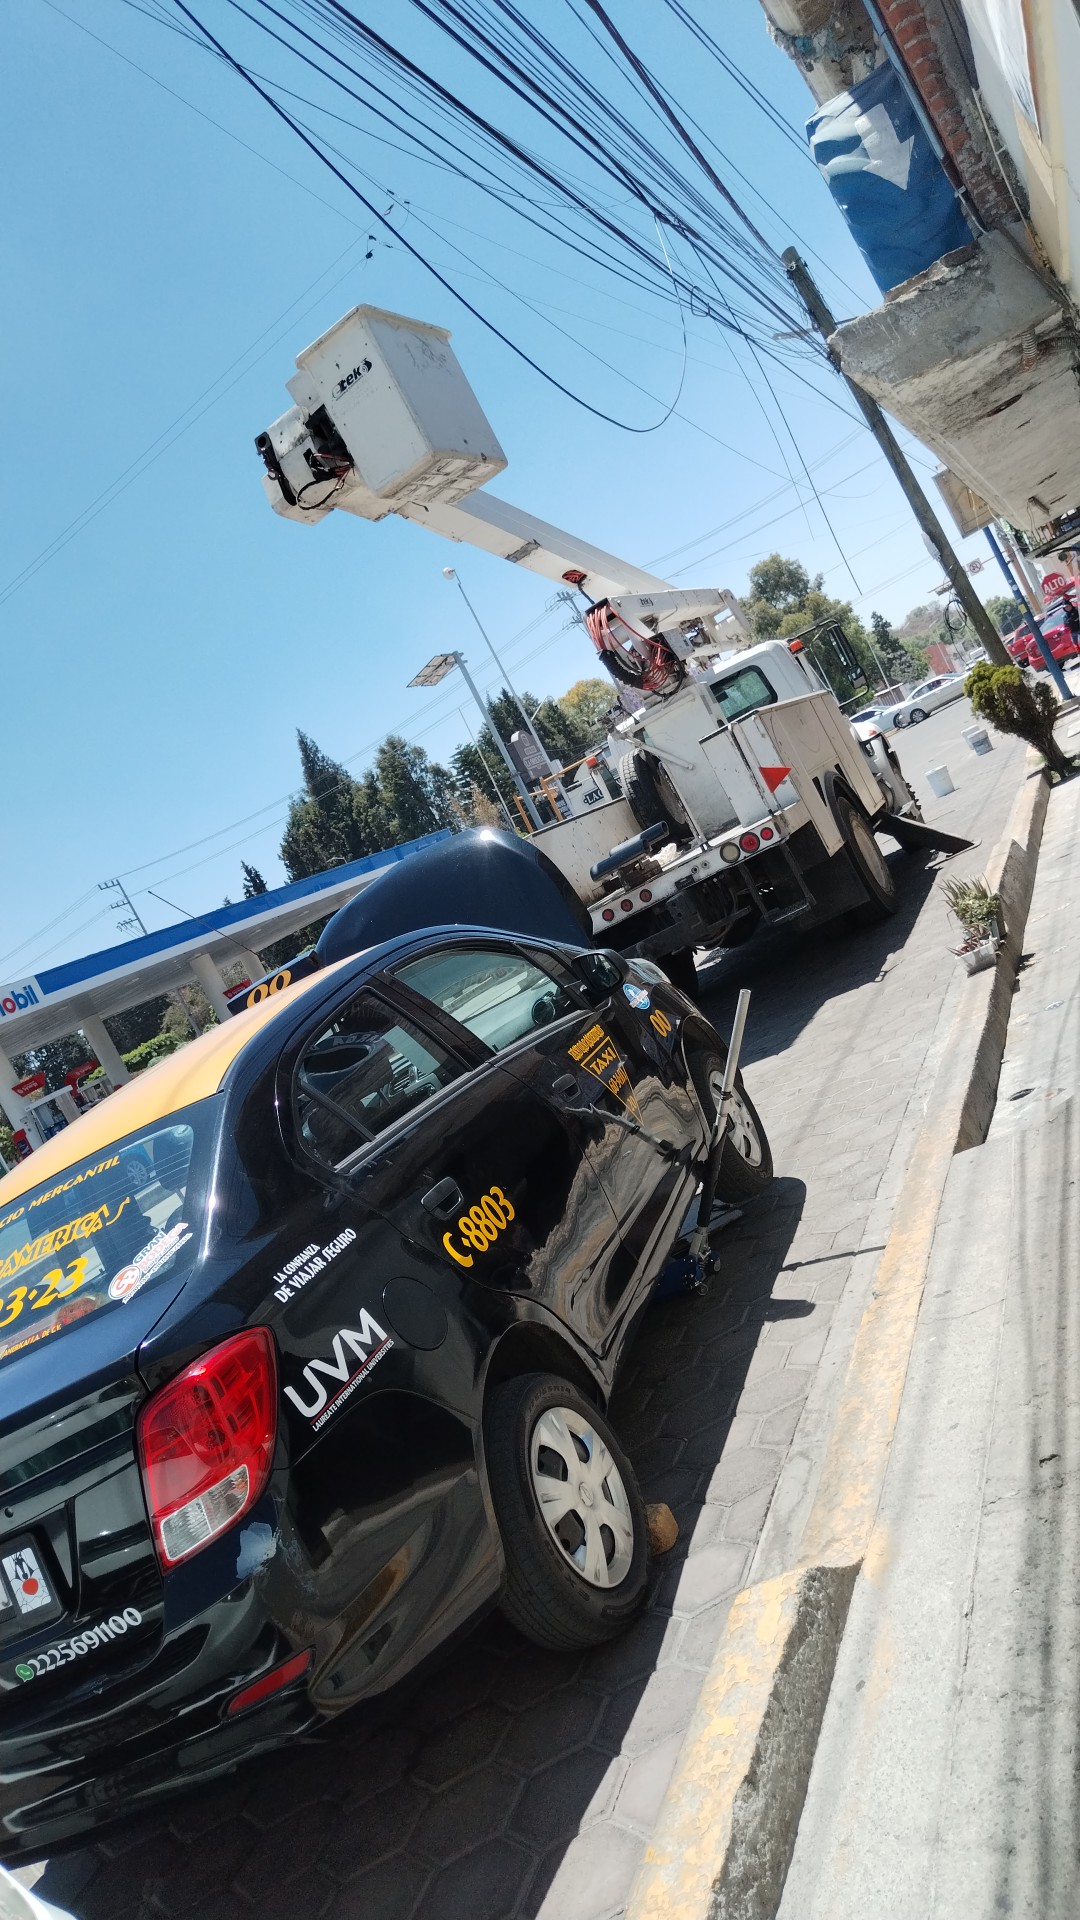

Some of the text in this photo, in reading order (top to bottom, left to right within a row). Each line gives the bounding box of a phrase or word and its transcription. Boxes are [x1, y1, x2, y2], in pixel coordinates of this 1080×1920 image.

[1043, 576, 1065, 595] ALTO
[589, 1046, 617, 1075] TAXI
[28, 1155, 120, 1212] MERCANTIL
[134, 1231, 166, 1264] GRAN
[139, 1223, 188, 1270] BODEGA
[273, 1243, 320, 1284] LA CONFIANZA
[273, 1228, 357, 1303] DE VIAJAR SEGURO
[283, 1307, 388, 1418] UVM
[312, 1339, 395, 1432] LAUREATE INTERNATIONAL UNIVERSITIES
[27, 1607, 142, 1676] 2225691100
